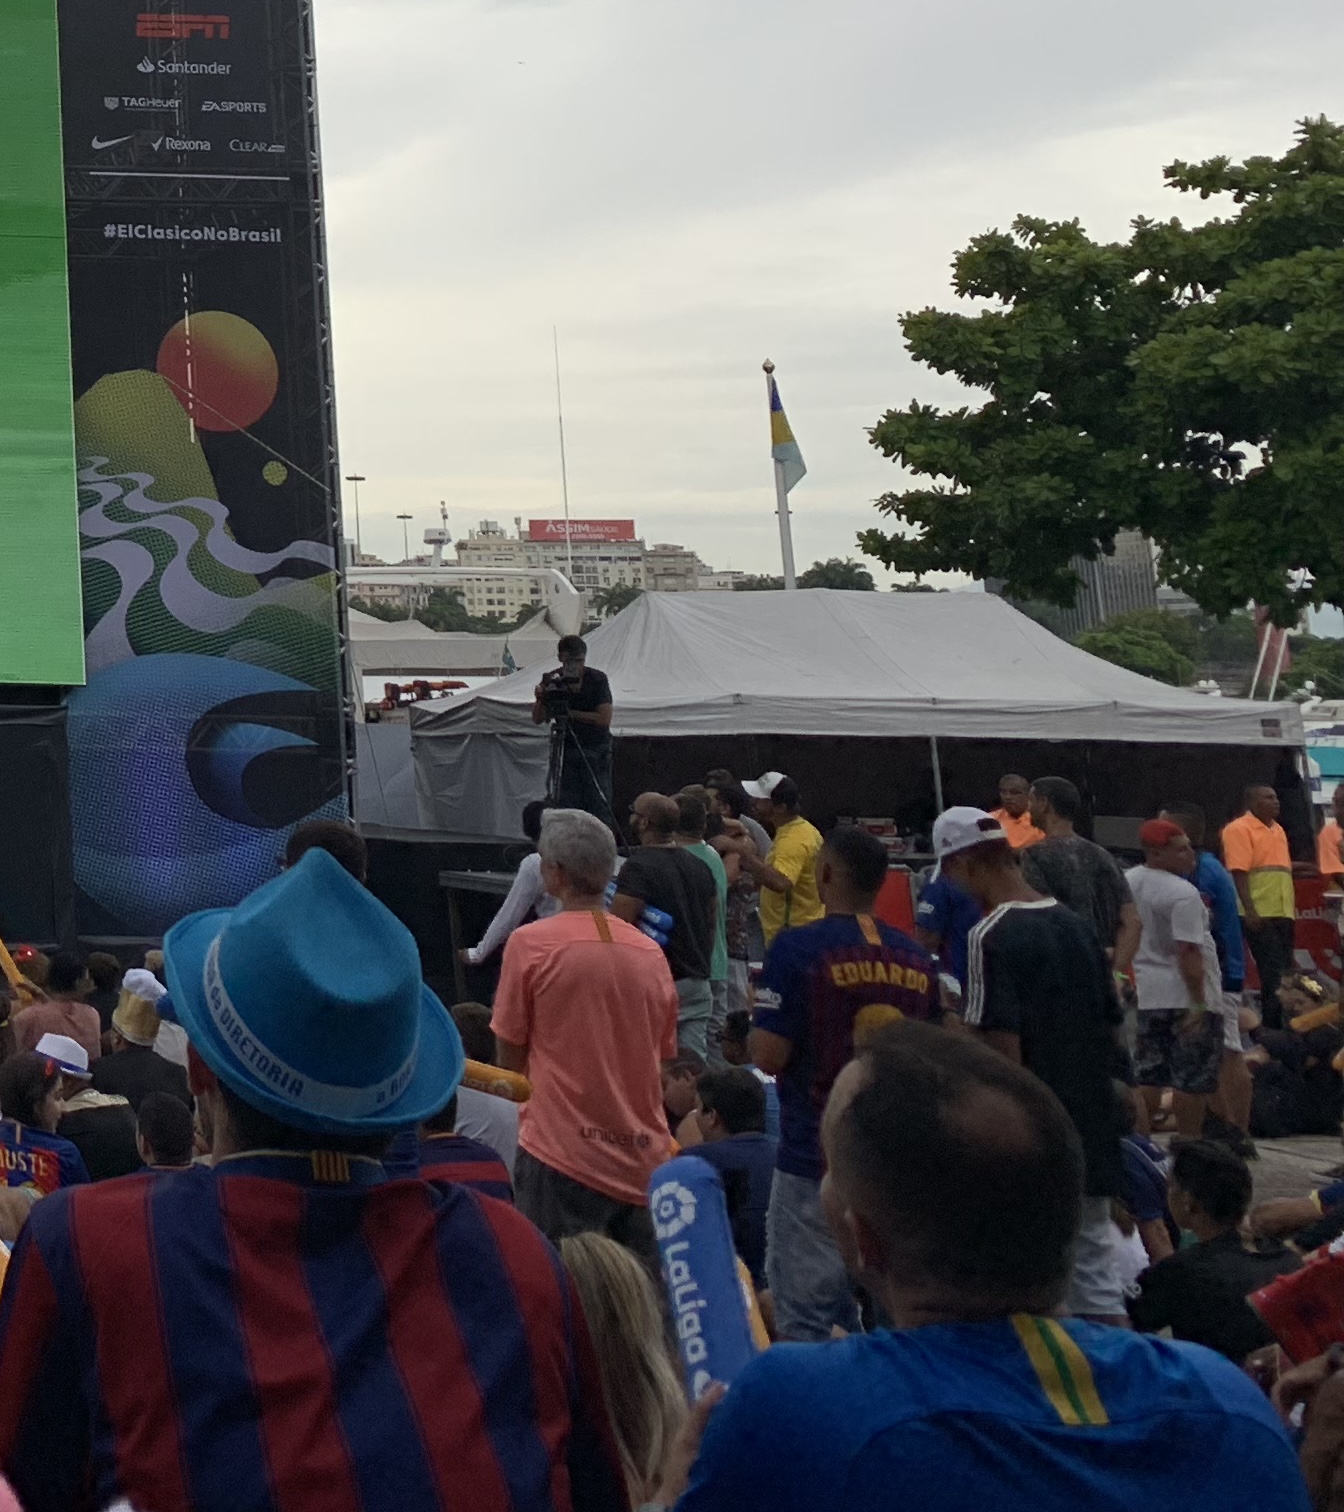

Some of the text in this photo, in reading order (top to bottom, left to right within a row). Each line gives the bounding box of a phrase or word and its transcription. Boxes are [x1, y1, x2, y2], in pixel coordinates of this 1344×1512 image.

[135, 13, 231, 39] ESPN
[157, 60, 233, 75] Santander
[165, 137, 212, 152] Rexona
[103, 223, 282, 243] #ElClasicoNoBrasil
[831, 960, 929, 995] EDUARDO
[664, 1241, 708, 1364] LaLiga
